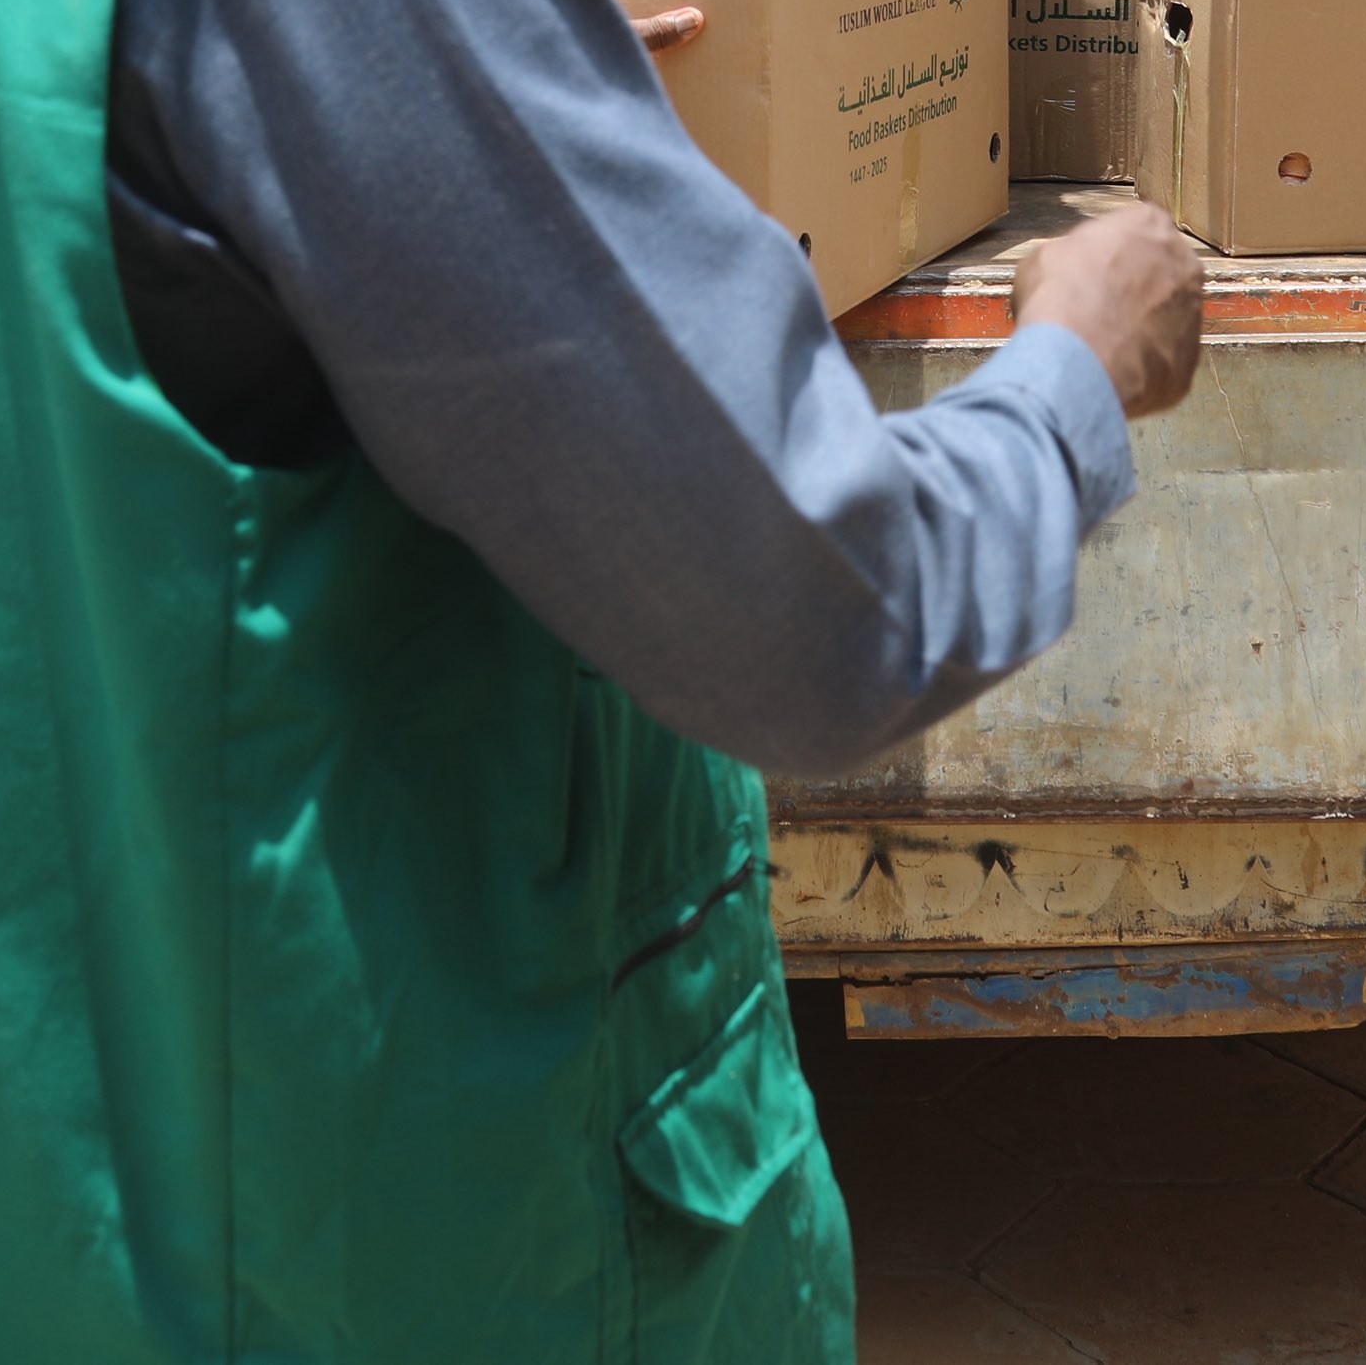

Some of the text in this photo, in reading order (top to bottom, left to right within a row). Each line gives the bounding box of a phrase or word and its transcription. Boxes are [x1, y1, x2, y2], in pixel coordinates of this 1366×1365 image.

[873, 0, 902, 23] WORLD
[1056, 35, 1138, 54] Distribu
[838, 45, 969, 115] توزيع السلال الغذائية
[849, 93, 957, 151] Food Baskets Distribution
[850, 165, 866, 184] 1447
[871, 156, 887, 177] 2025
